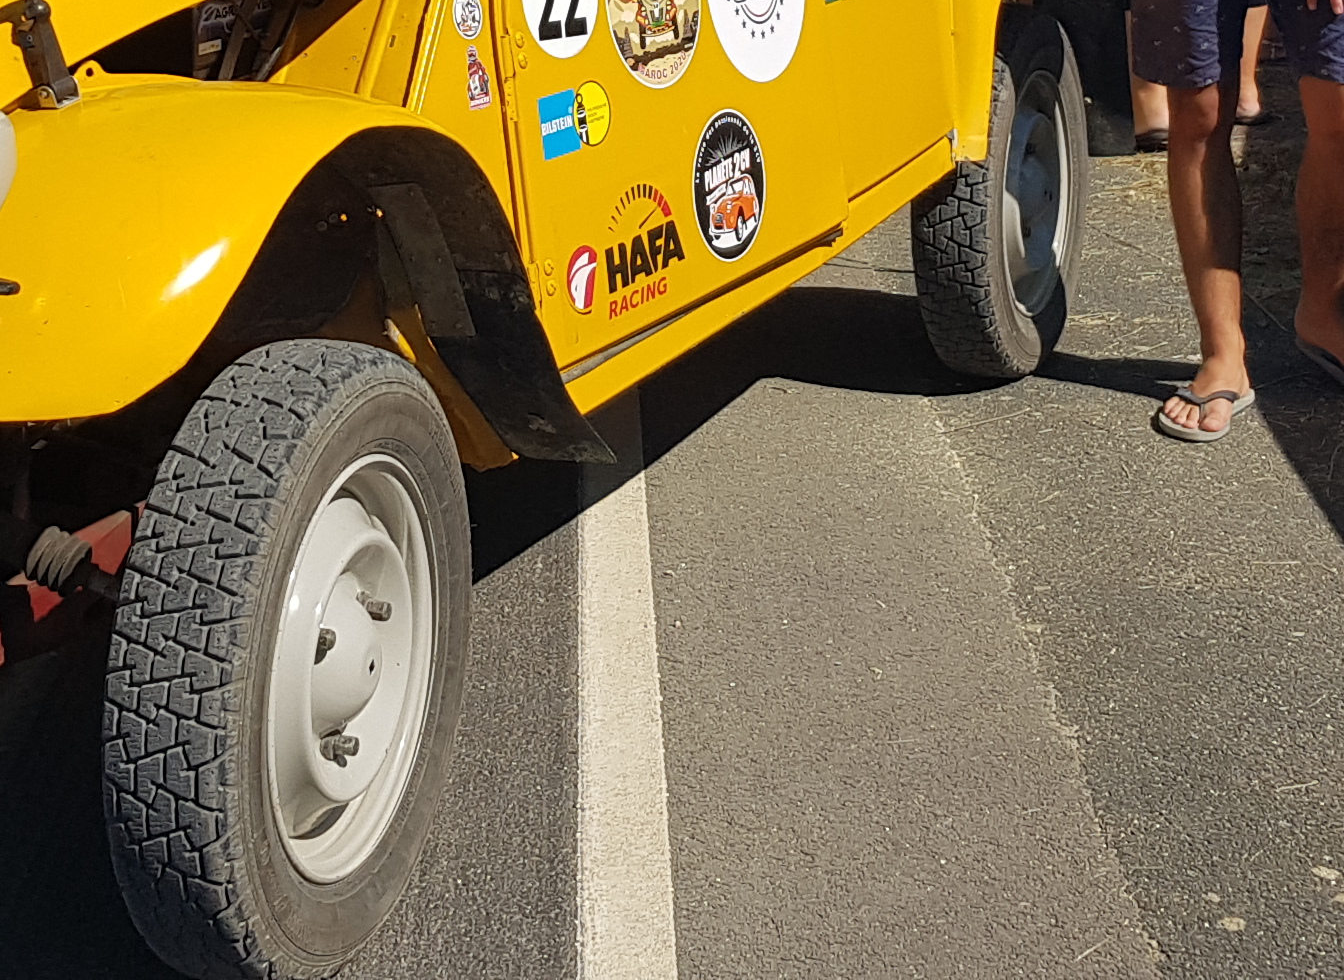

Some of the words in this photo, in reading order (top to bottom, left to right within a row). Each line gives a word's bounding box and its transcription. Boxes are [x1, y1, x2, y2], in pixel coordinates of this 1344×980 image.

[541, 114, 573, 137] BILSTEIN
[604, 219, 686, 295] HAFA
[609, 276, 668, 320] RACING
